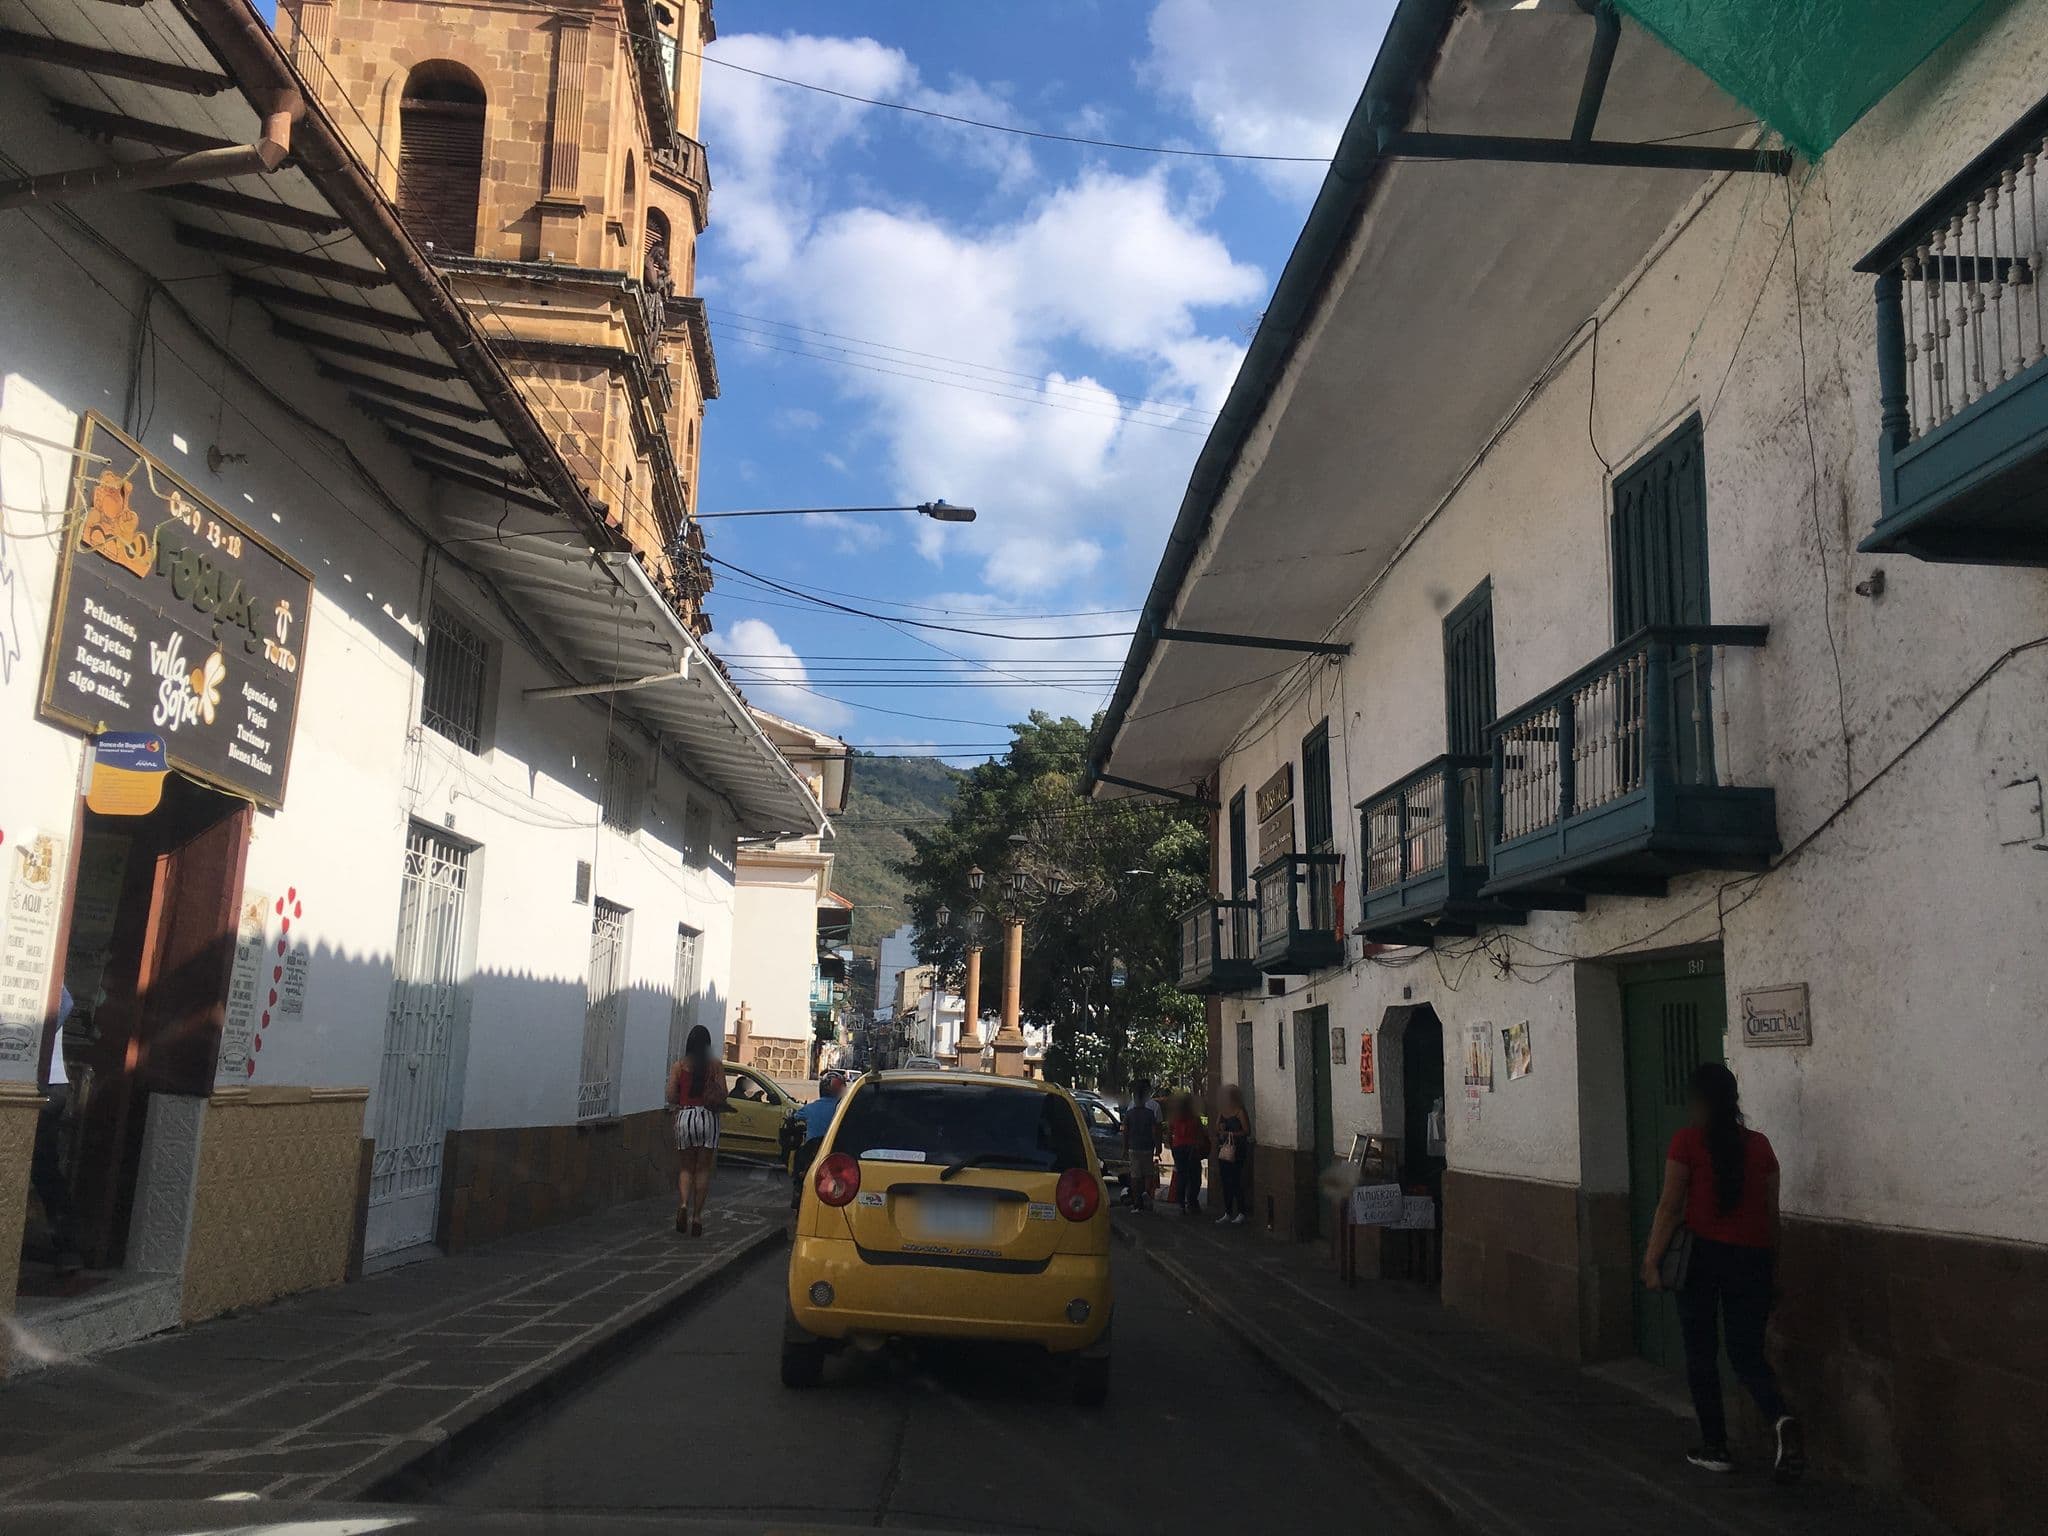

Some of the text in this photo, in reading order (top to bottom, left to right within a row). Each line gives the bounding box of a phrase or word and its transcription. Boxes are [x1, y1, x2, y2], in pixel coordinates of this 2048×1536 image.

[192, 510, 201, 535] 9
[83, 598, 137, 642] Peluches,
[84, 624, 132, 661] Tarjetas
[150, 631, 187, 680] Villa
[75, 645, 132, 688] Regalos y
[68, 671, 130, 709] algo más...
[242, 682, 278, 713] Agencia de
[247, 706, 267, 729] Viajes
[98, 741, 117, 749] Banco
[228, 742, 250, 766] Bienes
[237, 724, 271, 754] Turismo y
